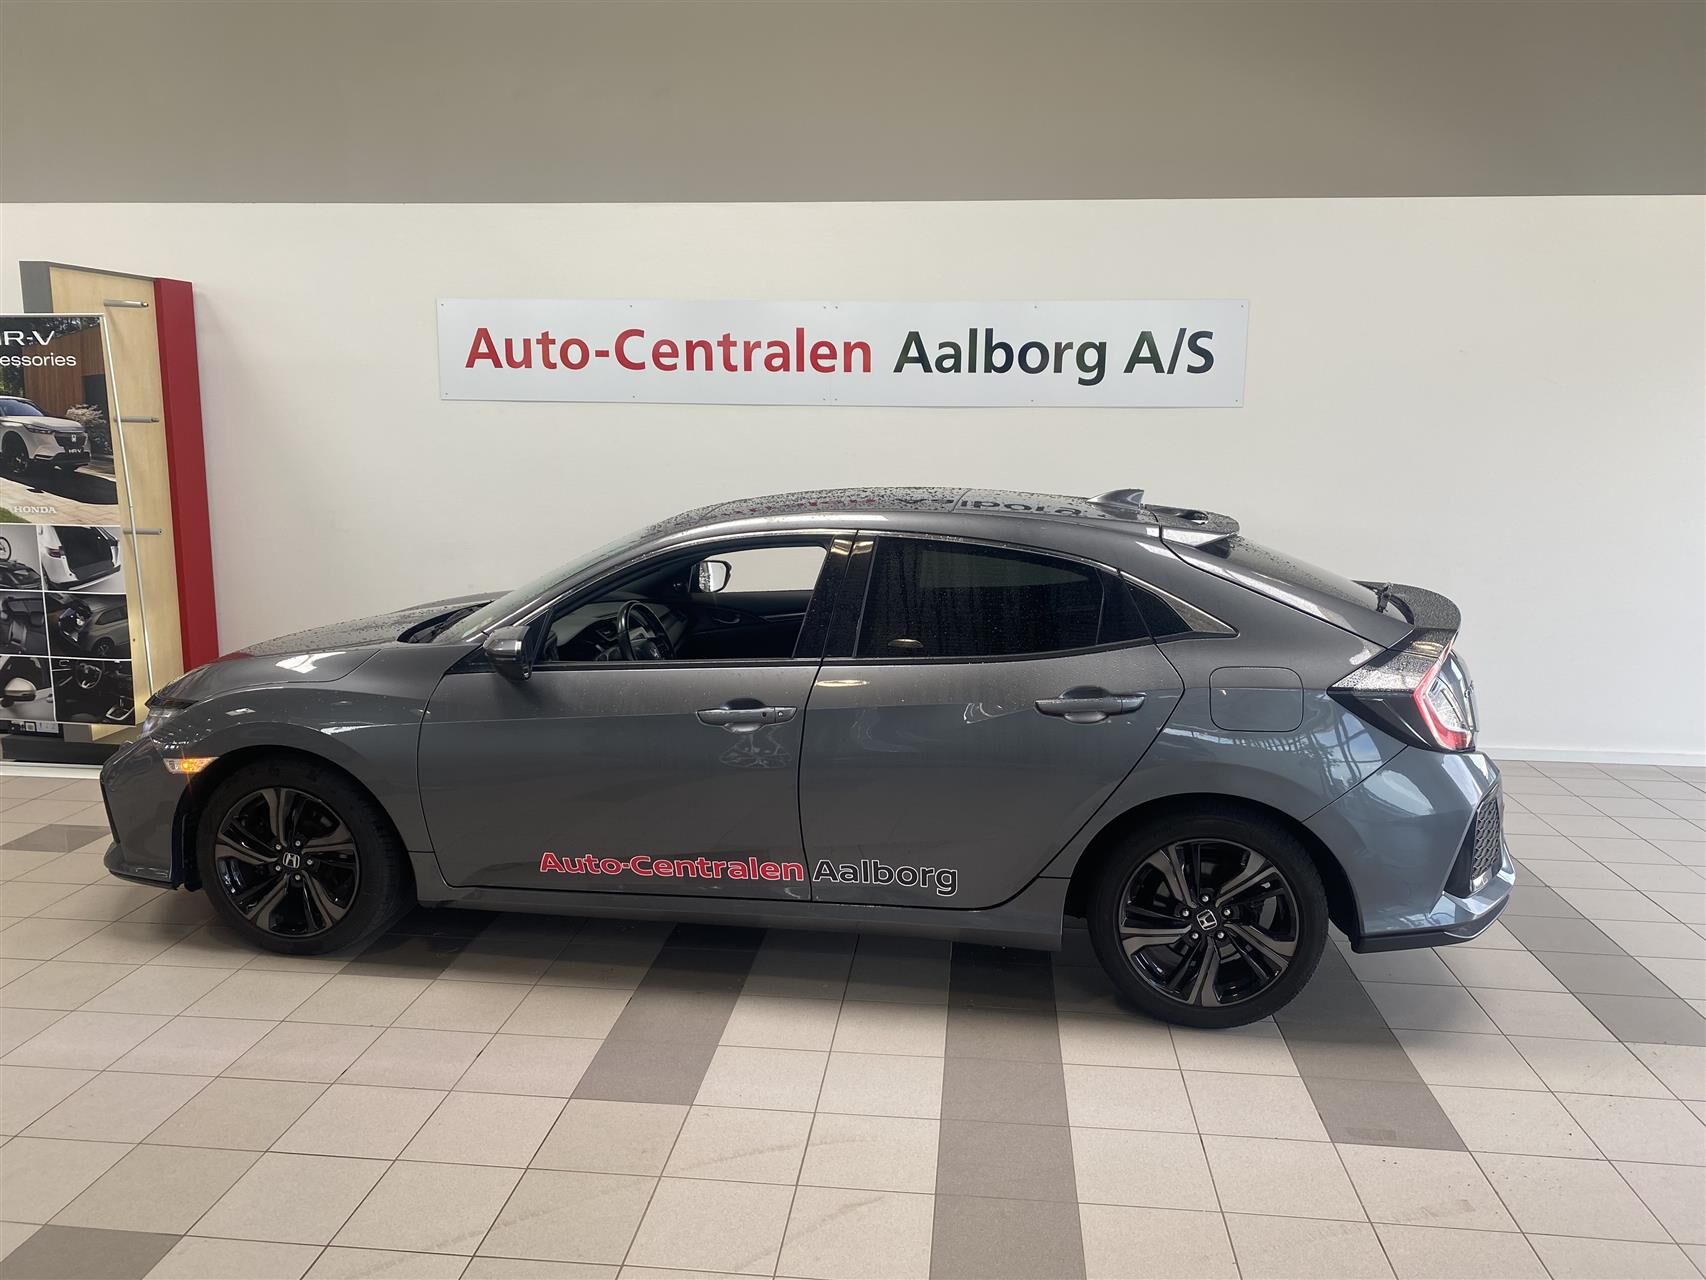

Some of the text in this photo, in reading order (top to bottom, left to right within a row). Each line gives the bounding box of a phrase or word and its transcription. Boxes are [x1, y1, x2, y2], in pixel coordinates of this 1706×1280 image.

[0, 330, 55, 345] R-V
[465, 327, 1214, 386] Auto-Centralen Aalborg A/S
[14, 505, 57, 514] HONDA
[539, 852, 958, 897] Auto-Centralen Aalborg
